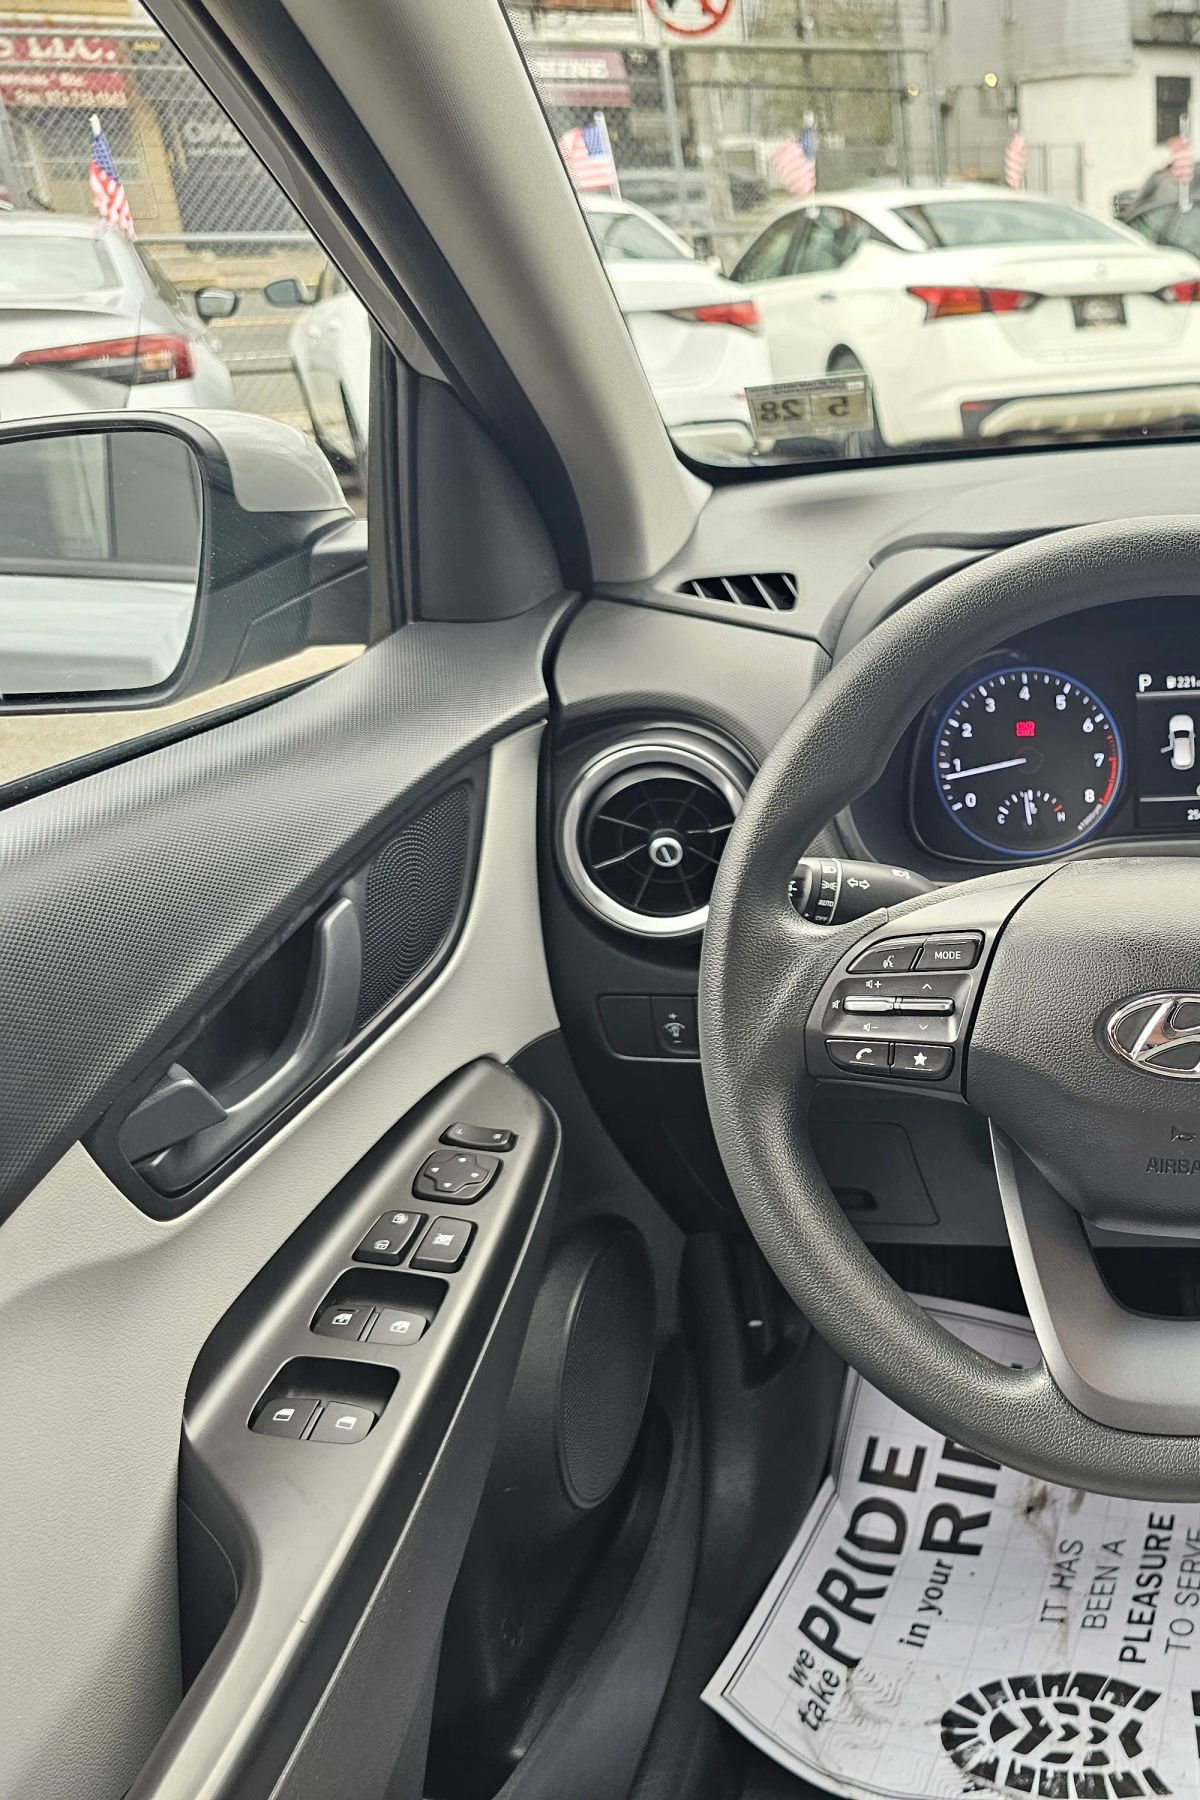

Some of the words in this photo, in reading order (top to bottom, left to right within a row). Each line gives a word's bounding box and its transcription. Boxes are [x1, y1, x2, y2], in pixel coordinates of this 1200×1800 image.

[1138, 673, 1152, 692] P
[1019, 686, 1030, 700] 4
[985, 698, 996, 712] 3
[1055, 695, 1066, 710] 5
[961, 722, 972, 737] 2
[1082, 717, 1094, 732] 6
[952, 758, 961, 772] 1
[1093, 753, 1105, 767] 7
[965, 792, 977, 808] 0
[1084, 789, 1095, 803] 8
[996, 813, 1006, 825] C
[1056, 811, 1066, 822] H
[817, 899, 835, 908] AUTO
[934, 950, 961, 960] MODE
[798, 1435, 927, 1669] PRIDE
[1049, 1539, 1085, 1590] HAS
[1080, 1565, 1120, 1629] BEEN
[1101, 1538, 1127, 1557] A
[1118, 1511, 1176, 1664] PLEASURE
[898, 1622, 931, 1648] in
[917, 1558, 954, 1615] your
[1040, 1598, 1068, 1623] IT
[1164, 1617, 1195, 1654] TO
[788, 1648, 815, 1688] we
[798, 1668, 841, 1732] take
